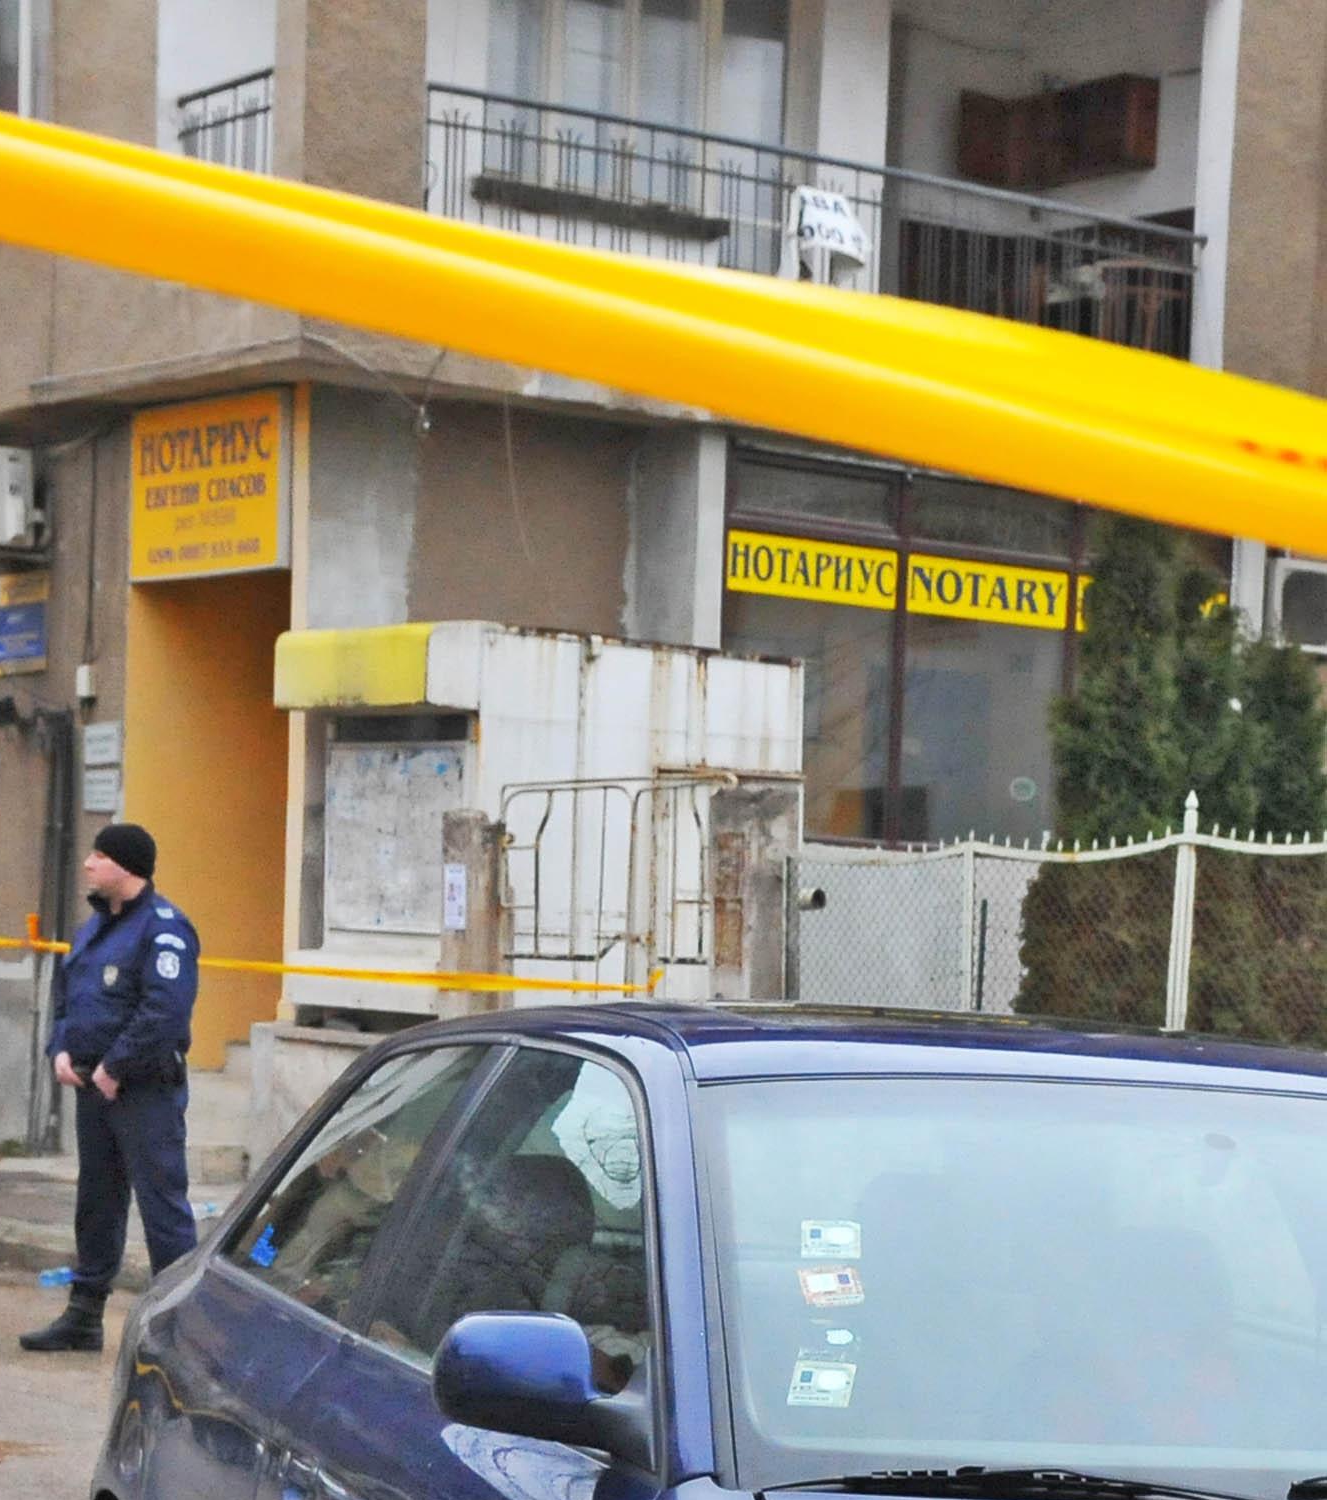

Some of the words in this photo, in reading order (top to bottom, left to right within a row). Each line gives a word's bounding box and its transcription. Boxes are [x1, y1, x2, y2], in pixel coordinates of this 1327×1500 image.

[139, 416, 271, 477] НОТАРИУС
[729, 542, 895, 597] НОТАРИУС
[911, 565, 1067, 617] NOTARY
